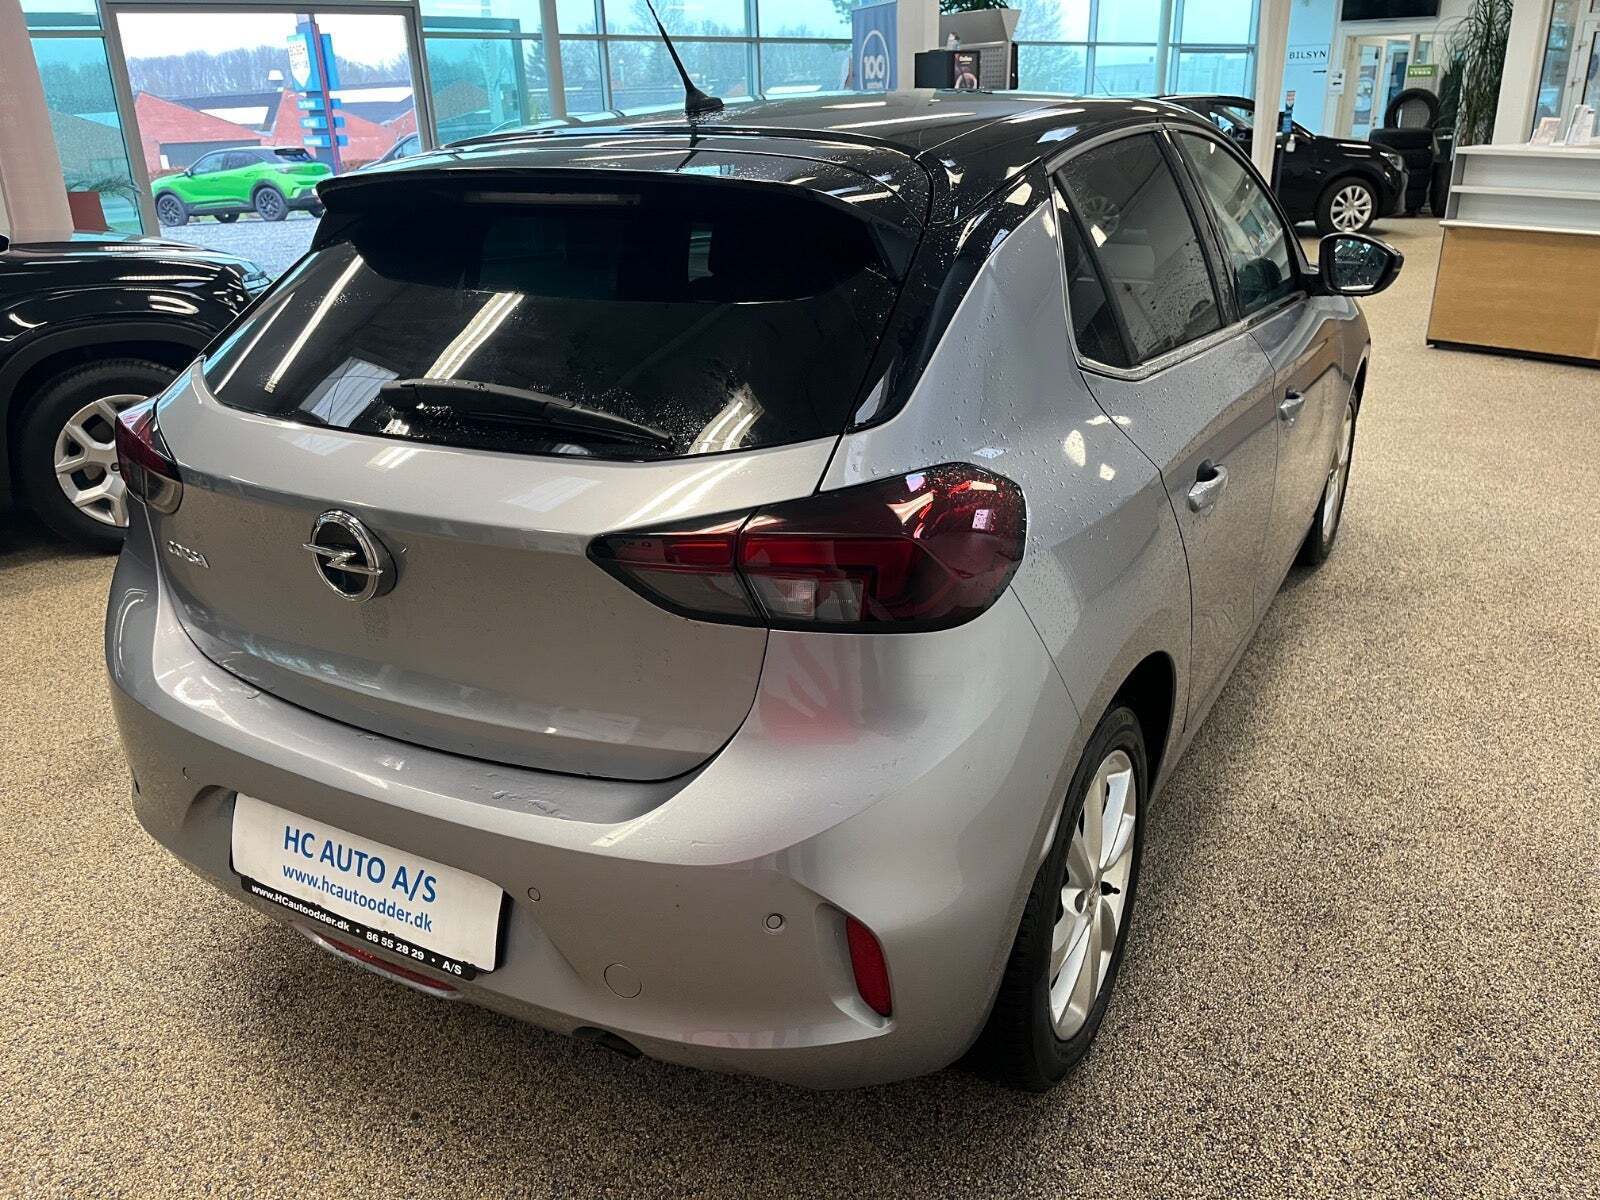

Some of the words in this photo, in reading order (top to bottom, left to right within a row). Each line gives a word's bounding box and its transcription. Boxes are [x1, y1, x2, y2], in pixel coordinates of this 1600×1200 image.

[864, 54, 885, 80] 100
[1289, 50, 1327, 60] BILSYN
[283, 864, 433, 932] www.hcautoodder.dk
[284, 825, 315, 858] HC
[320, 839, 386, 883] AUTO
[392, 865, 437, 903] A/S
[251, 885, 350, 932] www.HCautoodder.dk
[366, 931, 379, 943] 86
[381, 937, 394, 949] 55
[396, 943, 409, 955] 28
[411, 948, 424, 960] 29
[442, 960, 462, 975] A/S
